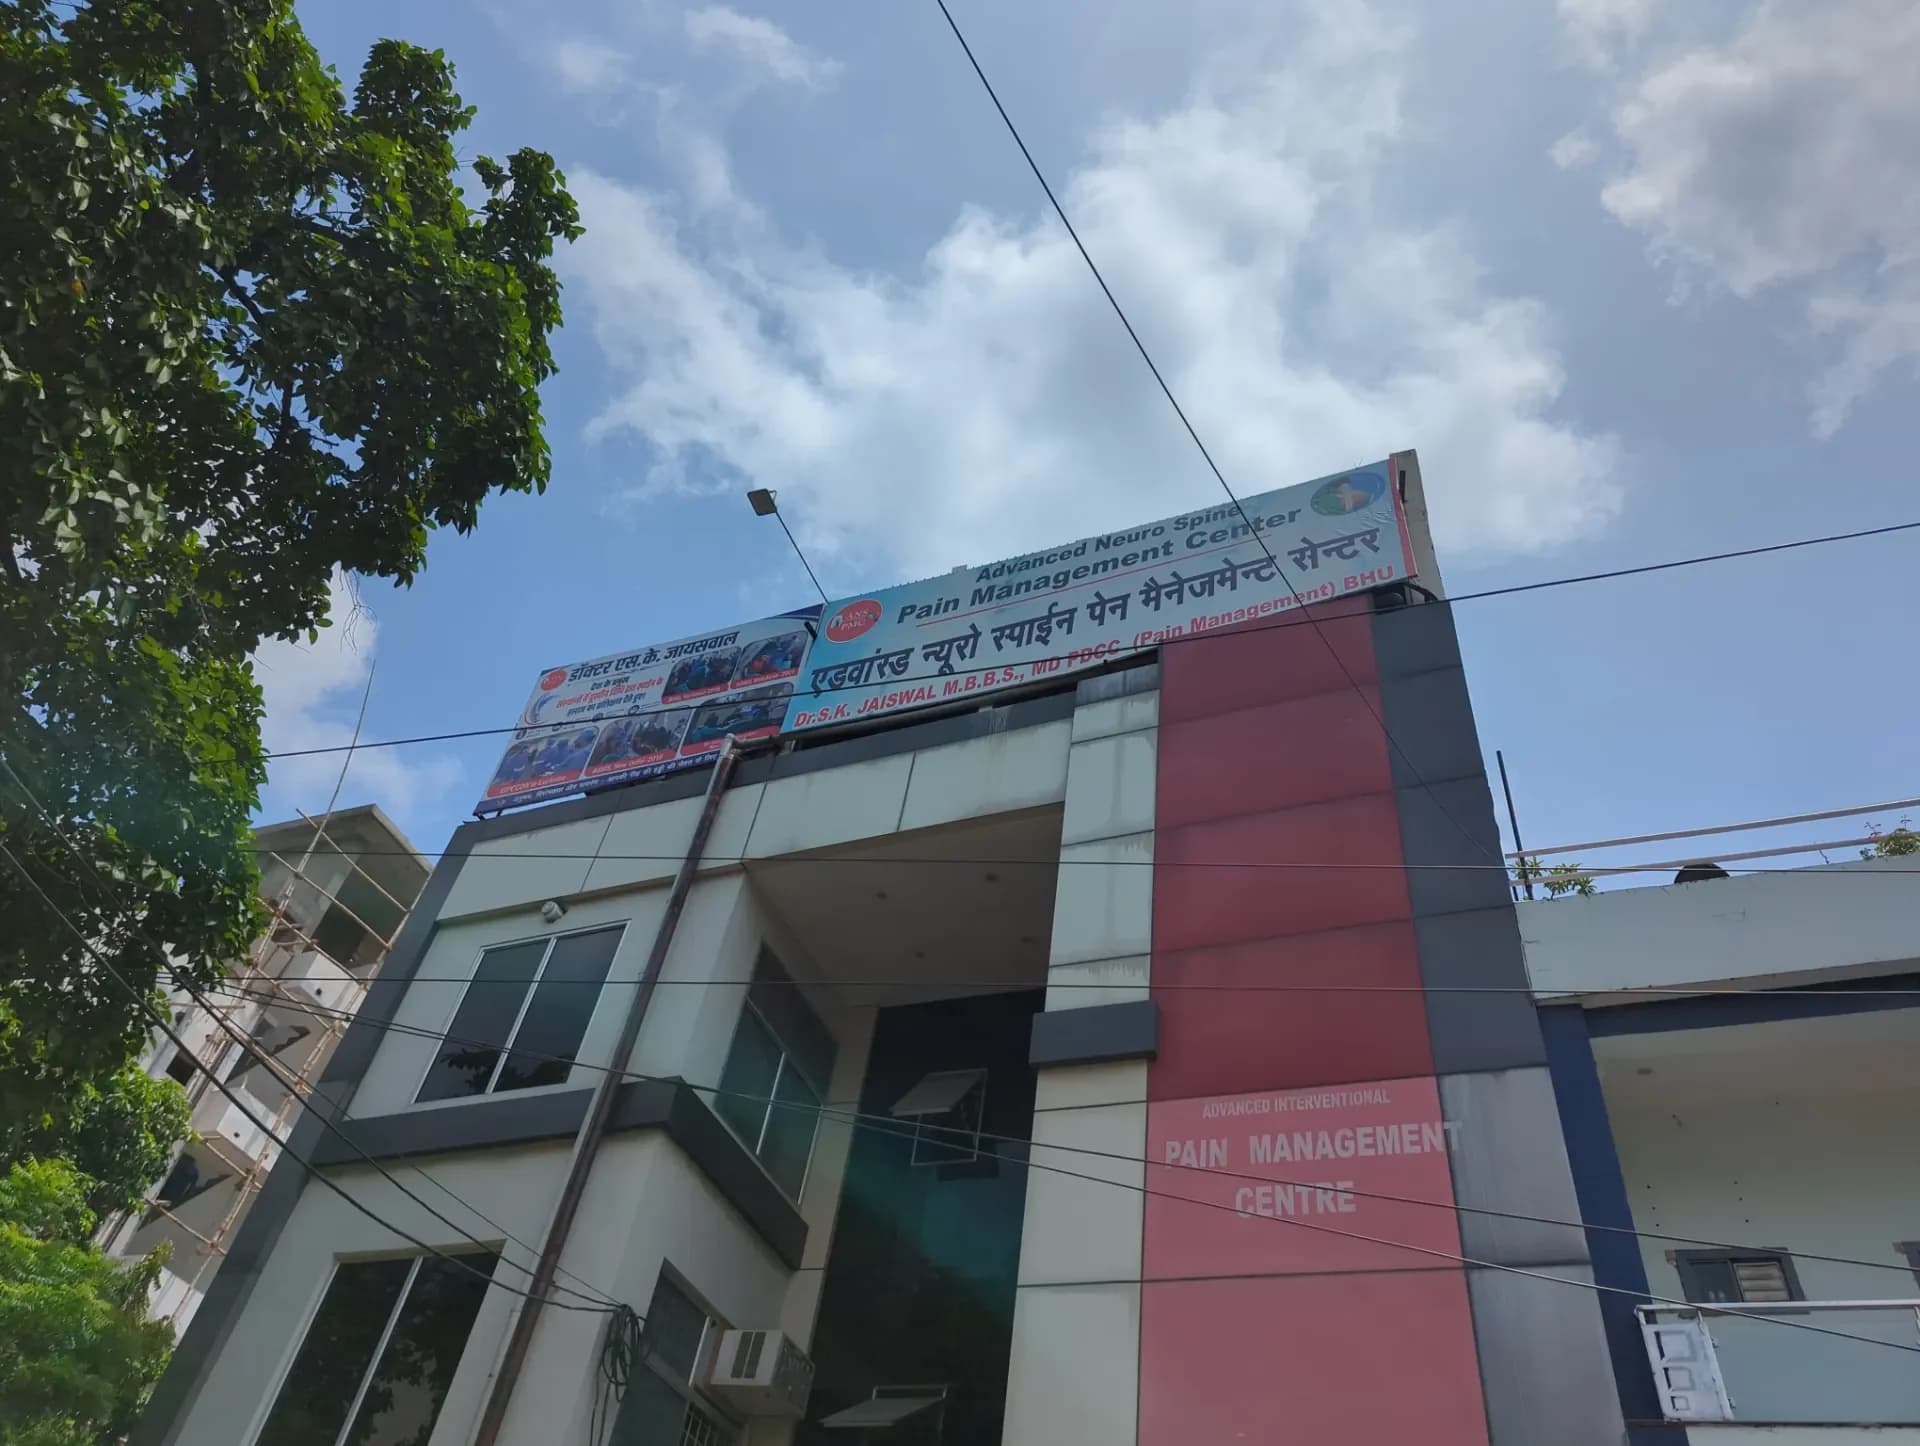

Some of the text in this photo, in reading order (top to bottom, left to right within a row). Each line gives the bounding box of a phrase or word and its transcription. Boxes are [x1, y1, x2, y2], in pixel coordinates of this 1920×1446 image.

[897, 509, 1301, 624] Pain Management Center
[976, 507, 1240, 583] Advanced Neuro Spine
[922, 623, 982, 674] न्यूरो
[991, 602, 1077, 651] स्पाईन
[1087, 591, 1131, 626] पेन
[1139, 555, 1277, 612] मैनेजमेन्ट
[1288, 527, 1380, 572] सेन्टर
[568, 661, 614, 682] डॉक्टर
[664, 631, 741, 660] जायसवाल
[857, 685, 937, 714] JAISWAL
[1032, 656, 1061, 676] MD
[1131, 624, 1184, 652] (Pain
[1190, 582, 1336, 633] Management)
[1343, 566, 1394, 591] BHU
[1202, 1088, 1391, 1119] ADVANCED INTERVENTIONAL
[1165, 1121, 1463, 1169] PAIN MANAGEMENT
[1235, 1180, 1356, 1217] CENTRE
